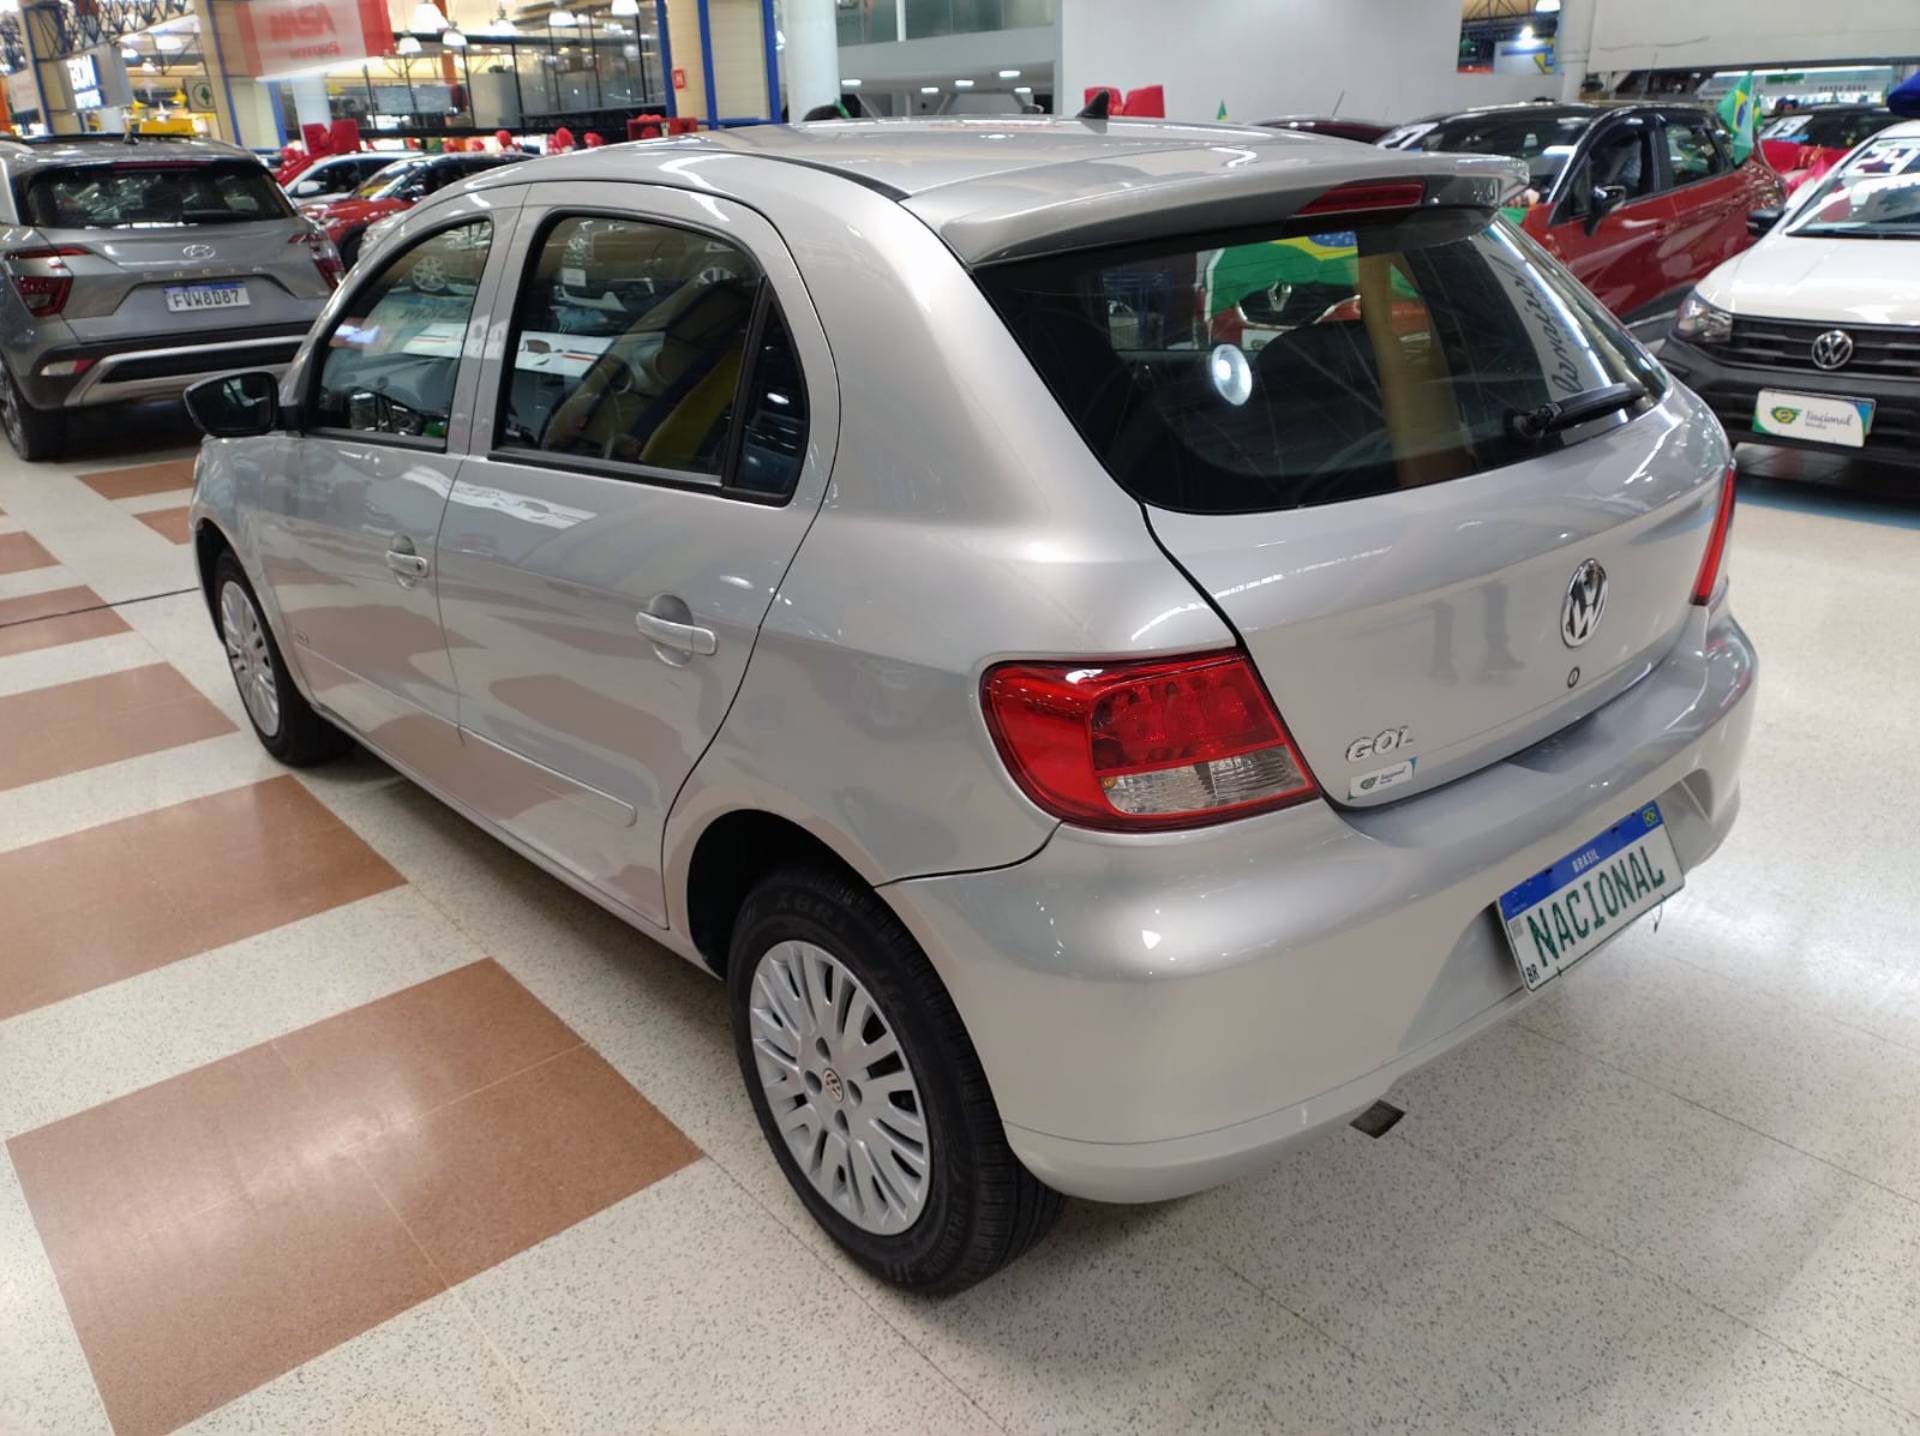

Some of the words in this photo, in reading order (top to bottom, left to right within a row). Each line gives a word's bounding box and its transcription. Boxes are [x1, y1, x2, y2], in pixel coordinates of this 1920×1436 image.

[1345, 725, 1415, 762] GOL
[1571, 848, 1600, 873] BRASIL
[1526, 846, 1666, 968] NACIONAL
[1526, 963, 1540, 983] BR
